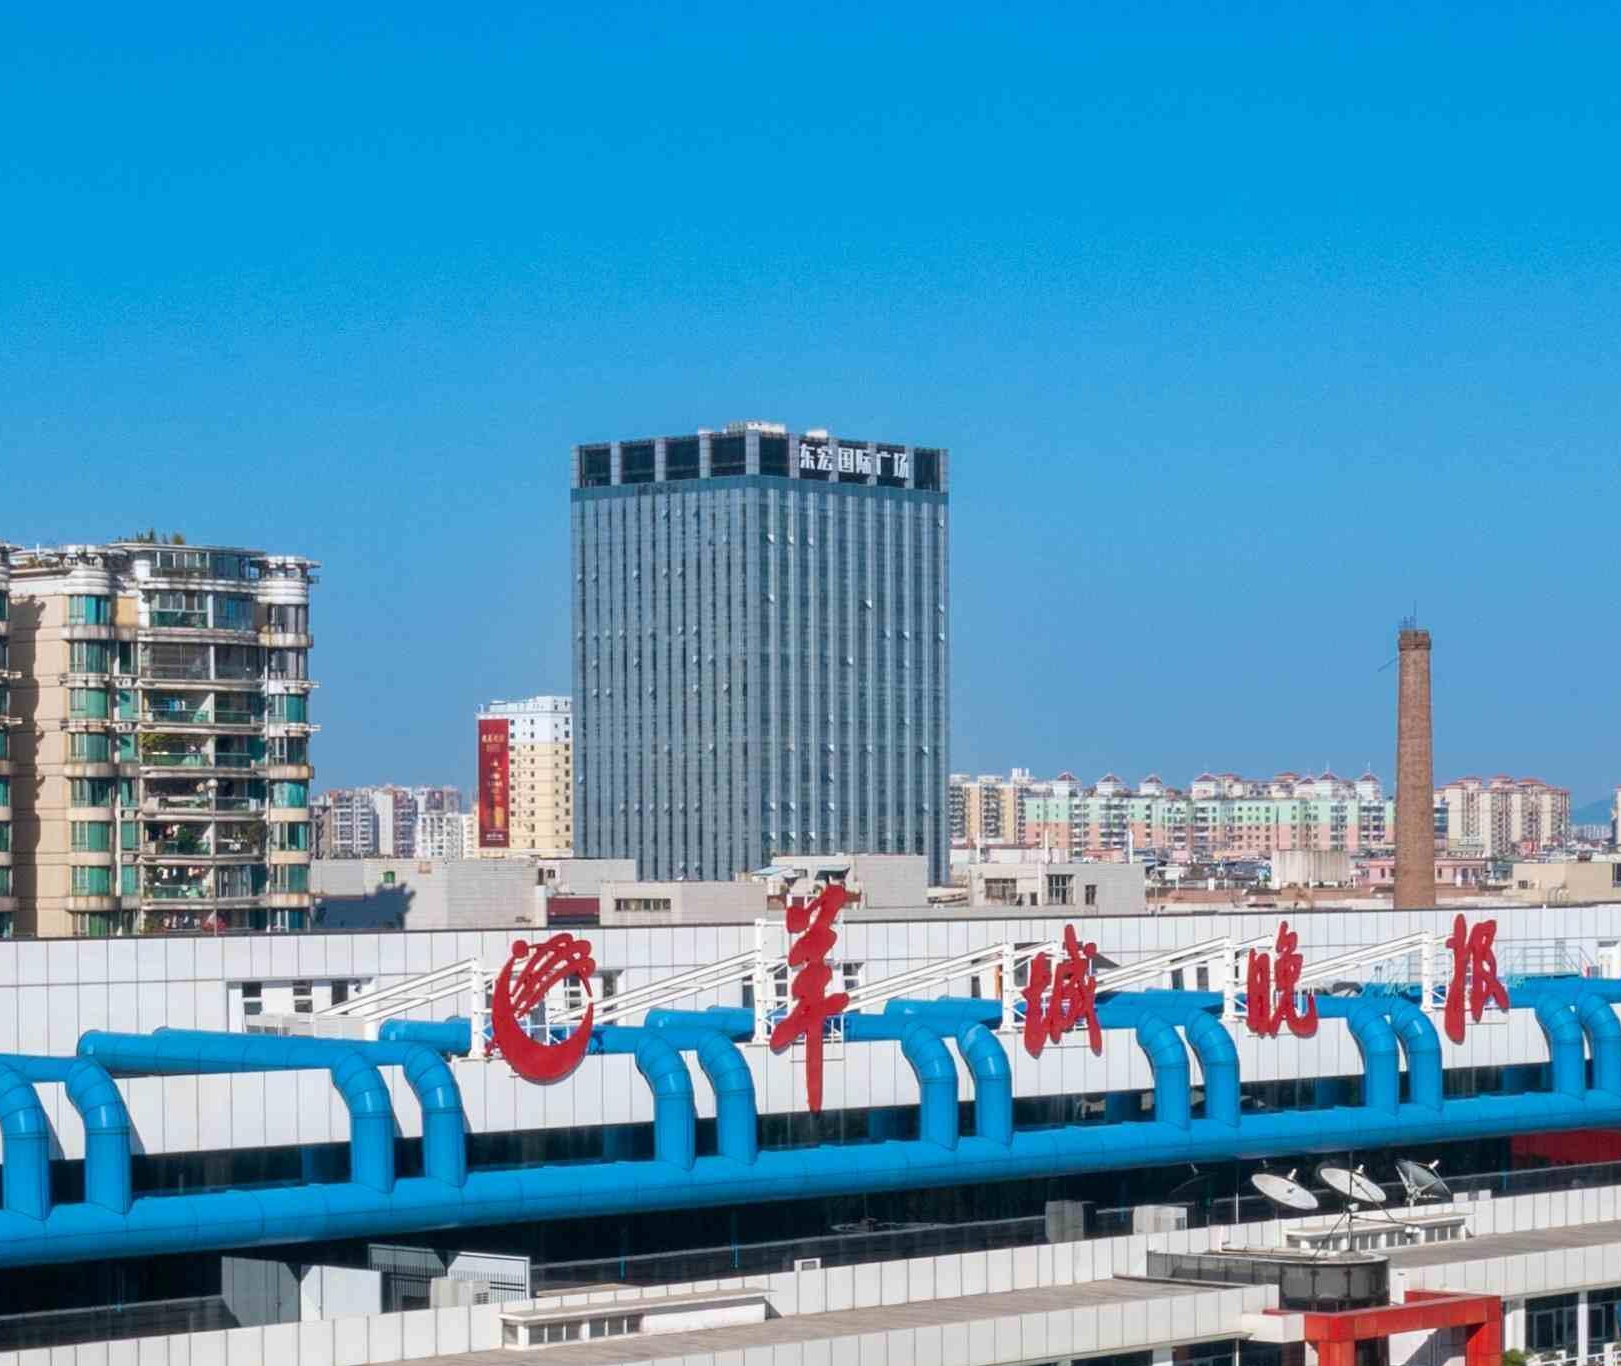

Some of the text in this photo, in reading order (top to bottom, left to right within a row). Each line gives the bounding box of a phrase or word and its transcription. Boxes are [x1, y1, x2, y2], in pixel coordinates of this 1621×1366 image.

[800, 443, 910, 478] 东宏国际广场
[769, 884, 1509, 1112] 羊城晚报
